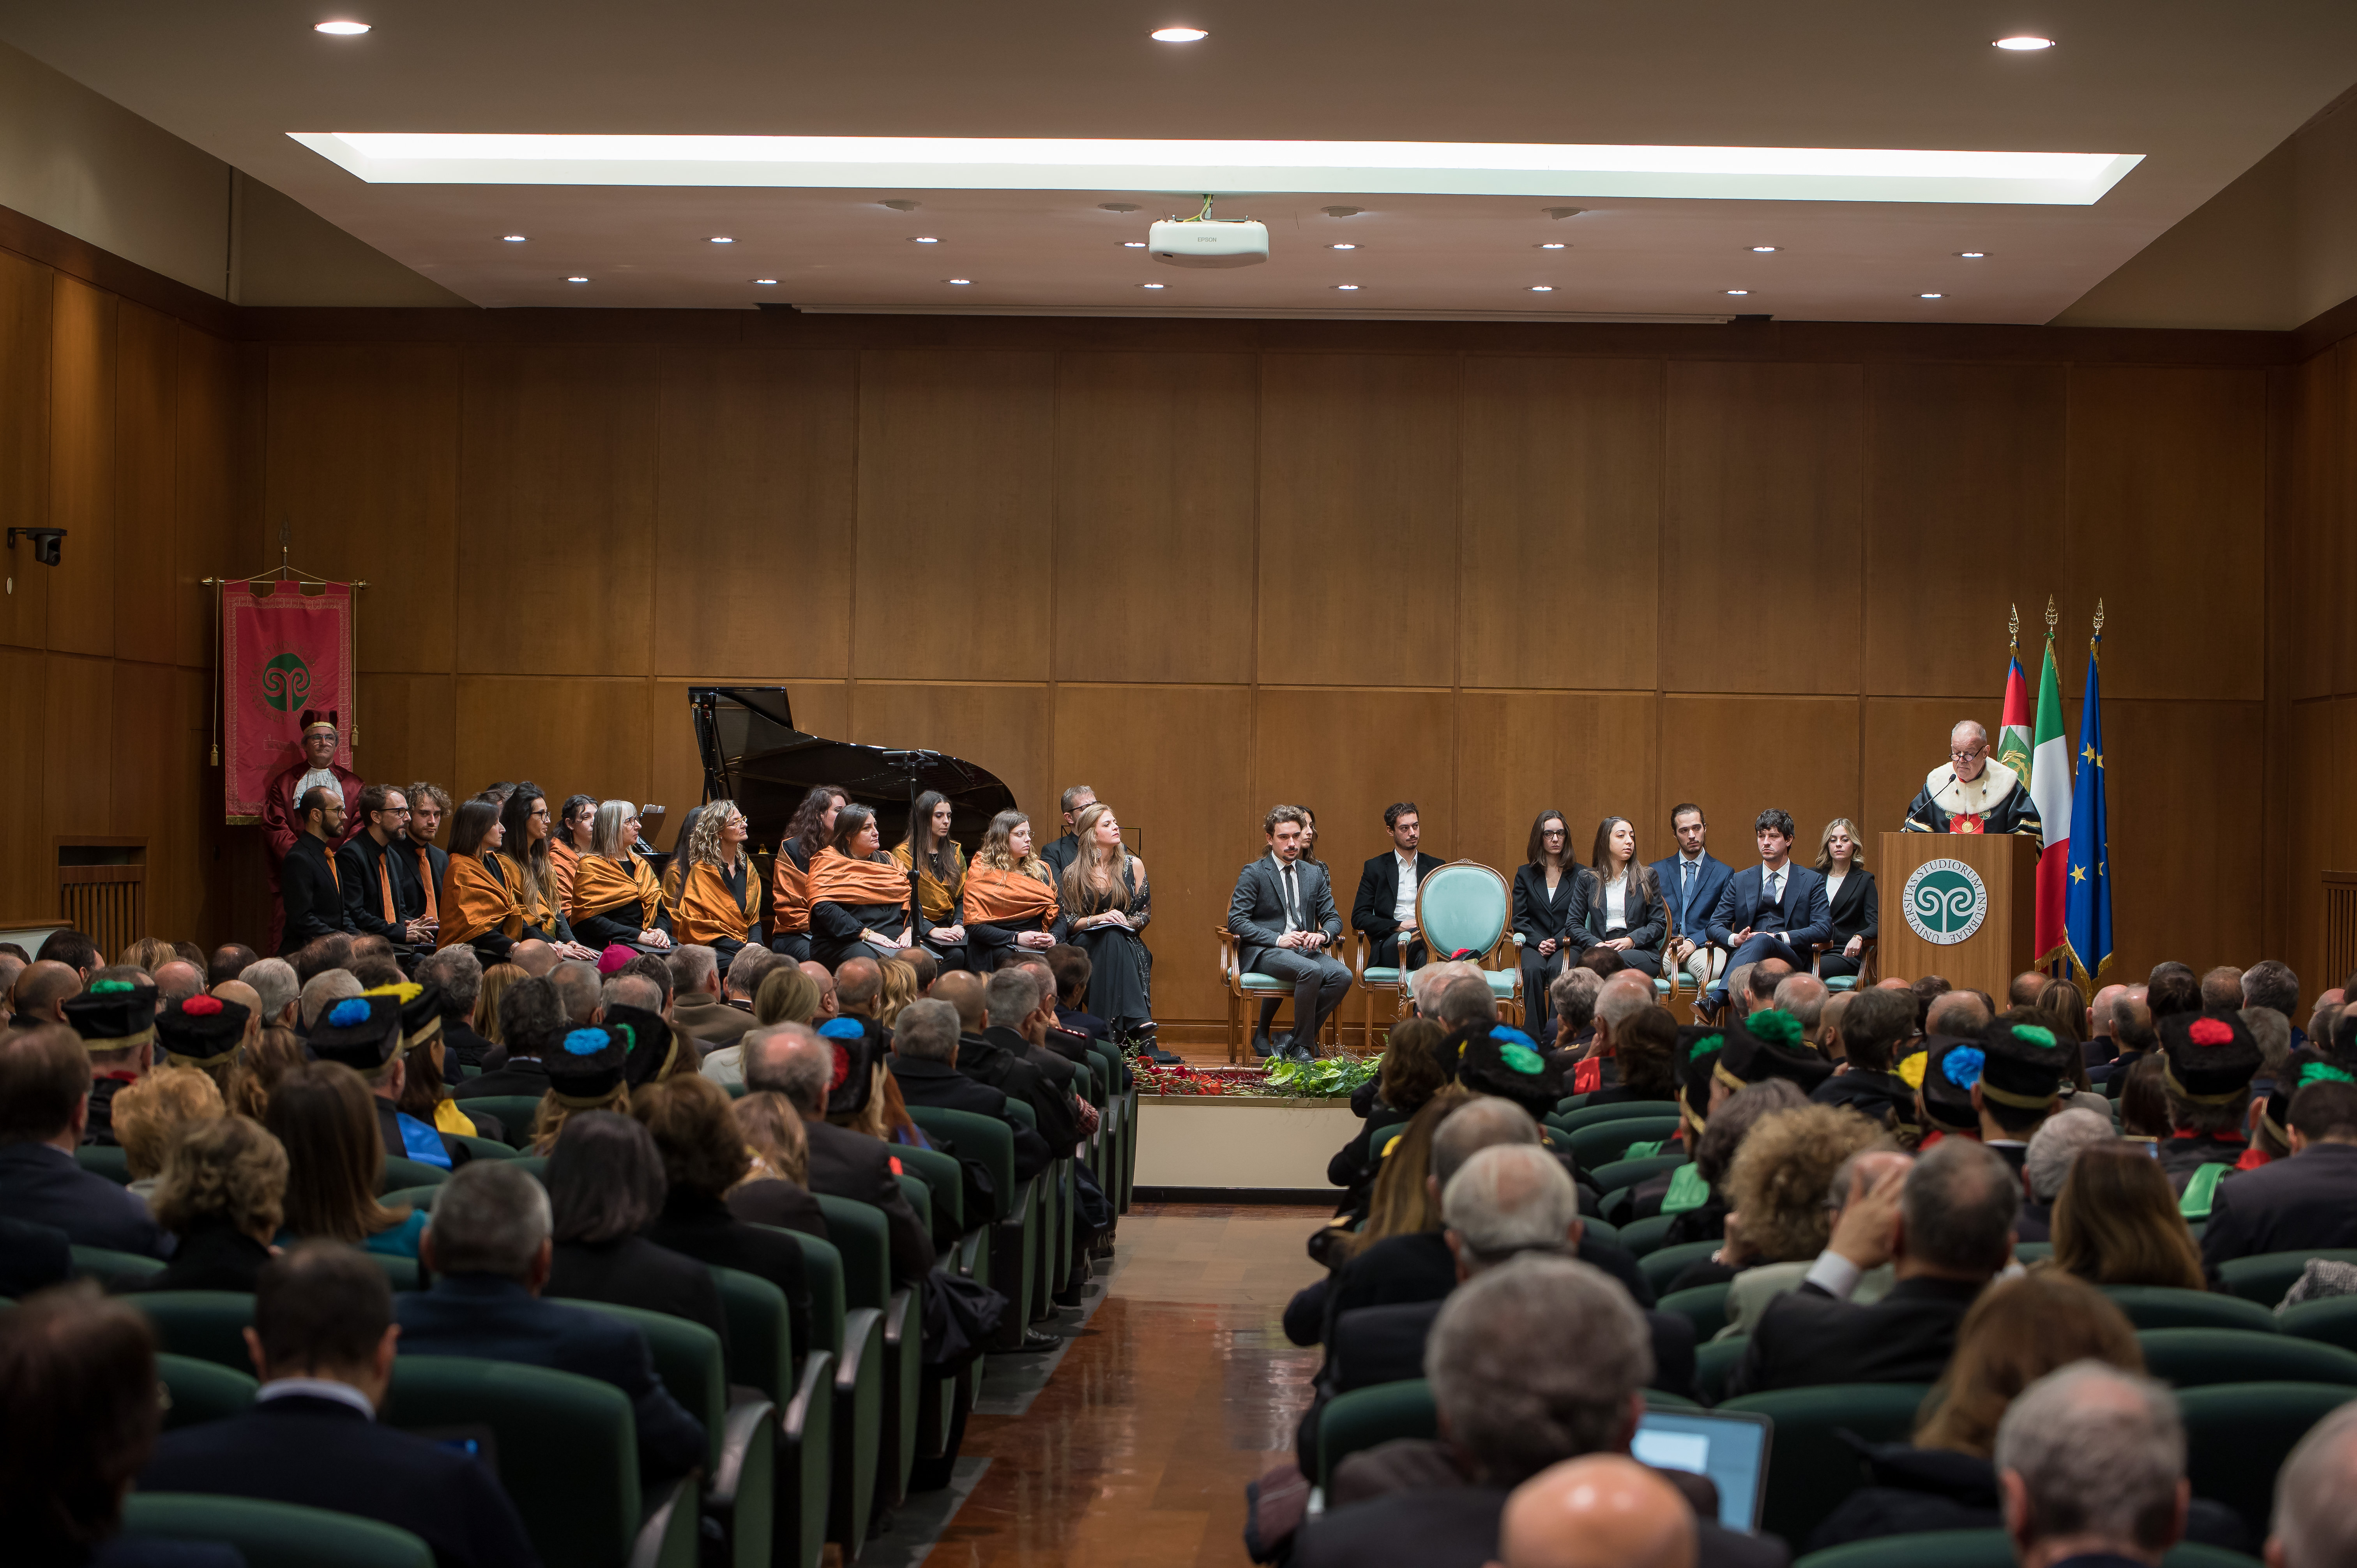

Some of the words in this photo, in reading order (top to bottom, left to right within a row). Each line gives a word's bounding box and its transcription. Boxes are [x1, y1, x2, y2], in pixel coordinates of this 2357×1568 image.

[1916, 860, 1982, 889] STUDIORUM
[1904, 877, 1939, 943] UNIVERSITAS
[1950, 891, 1986, 943] INSUBRIAE
